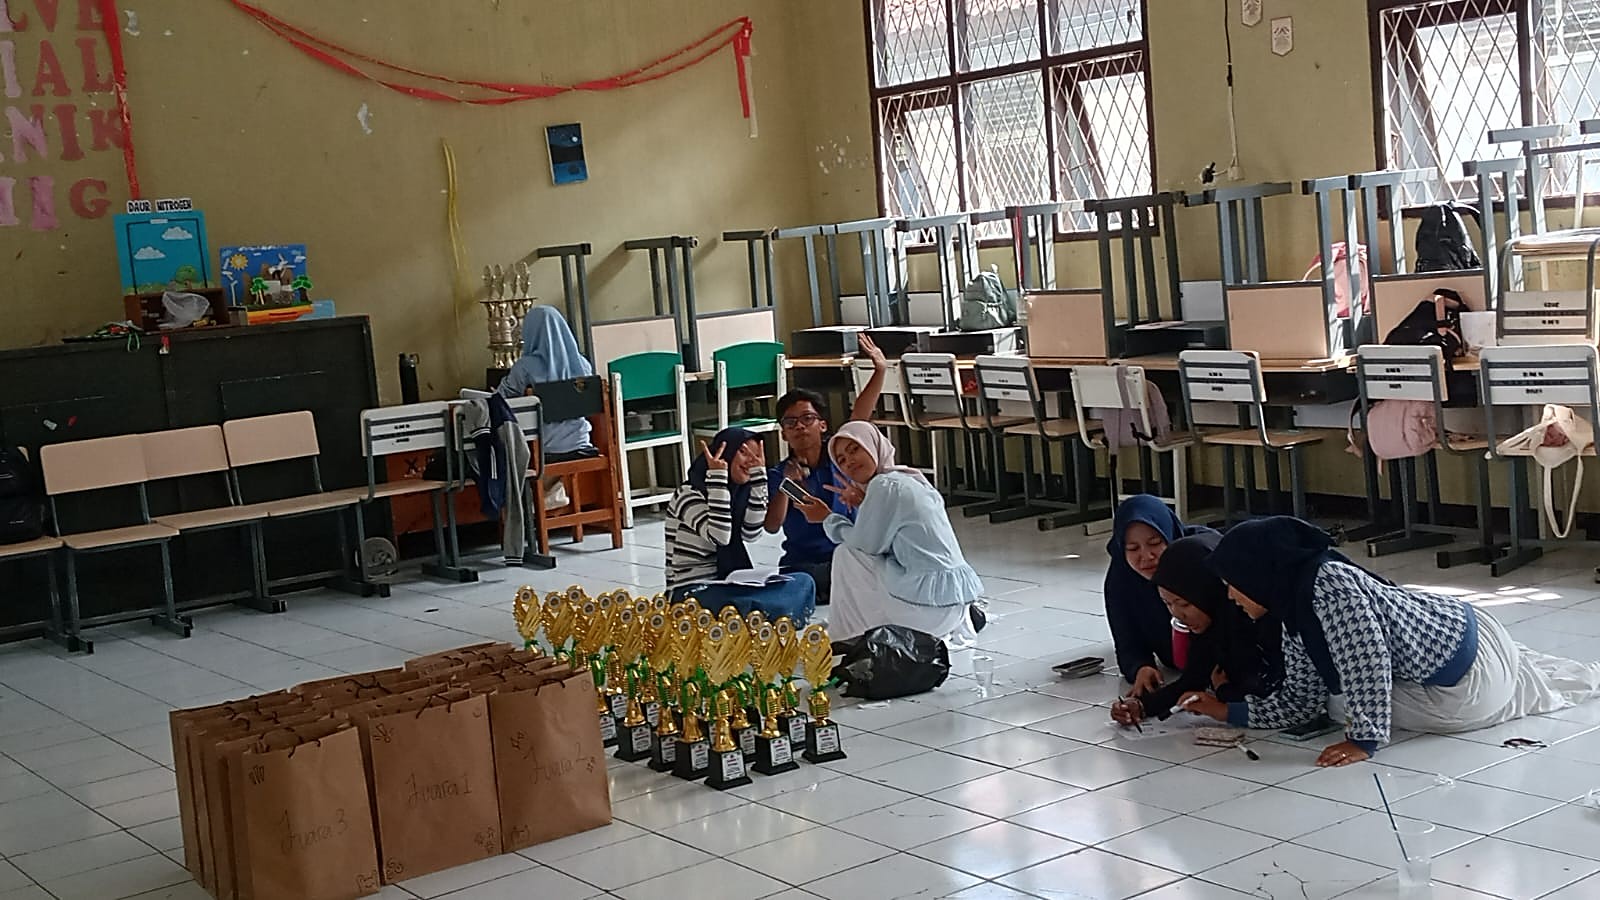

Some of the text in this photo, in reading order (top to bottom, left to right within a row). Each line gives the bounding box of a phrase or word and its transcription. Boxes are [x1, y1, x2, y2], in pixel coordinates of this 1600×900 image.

[0, 104, 123, 163] NIK
[127, 199, 192, 213] DAUR NITROGEN
[575, 741, 588, 762] 2
[405, 770, 473, 806] Juara 1
[281, 808, 348, 856] Juara 3
